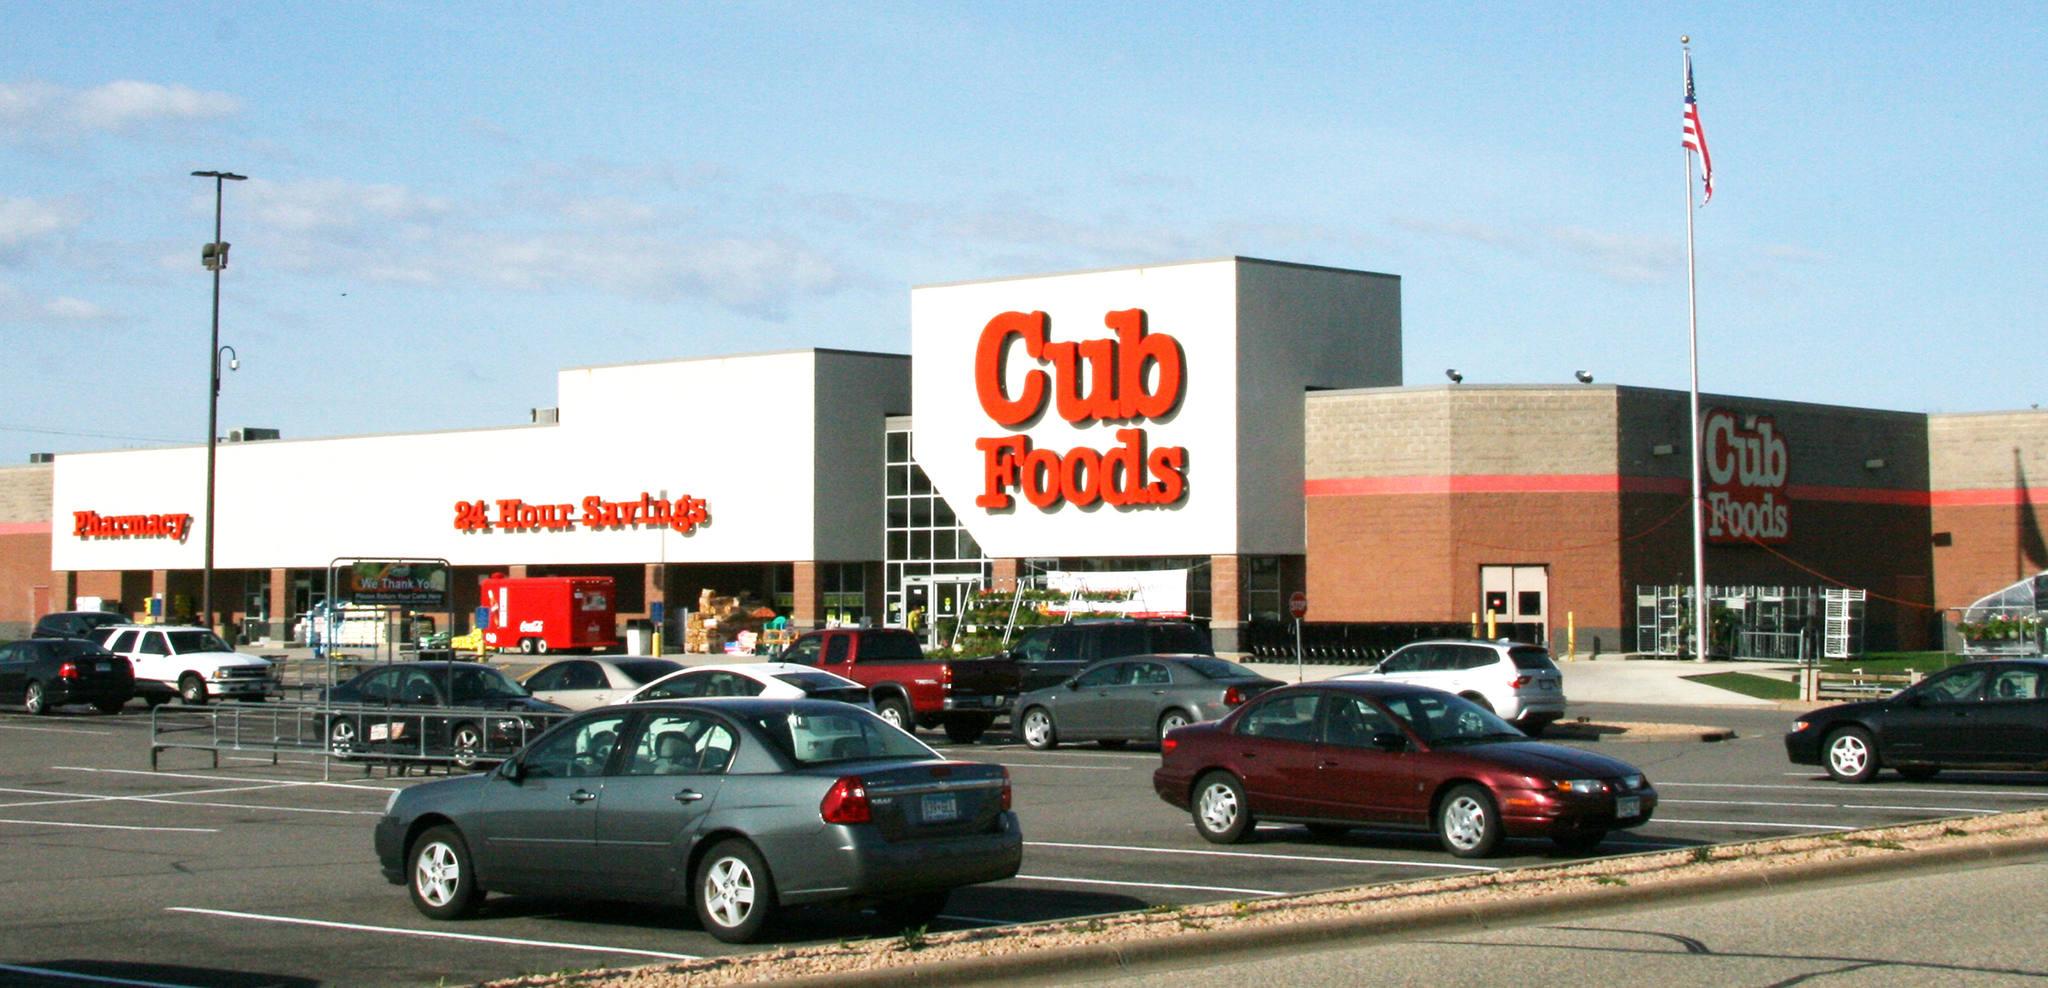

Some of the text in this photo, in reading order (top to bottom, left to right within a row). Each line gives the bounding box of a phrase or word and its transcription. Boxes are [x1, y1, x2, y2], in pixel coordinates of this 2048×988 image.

[974, 308, 1183, 426] Cub
[974, 428, 1185, 508] Foods
[1706, 414, 1787, 487] Cub
[73, 510, 190, 541] Pharmacy
[454, 492, 708, 533] 24 Hour Savings
[1708, 491, 1788, 538] Foods
[361, 577, 378, 589] We
[381, 577, 413, 590] Thank
